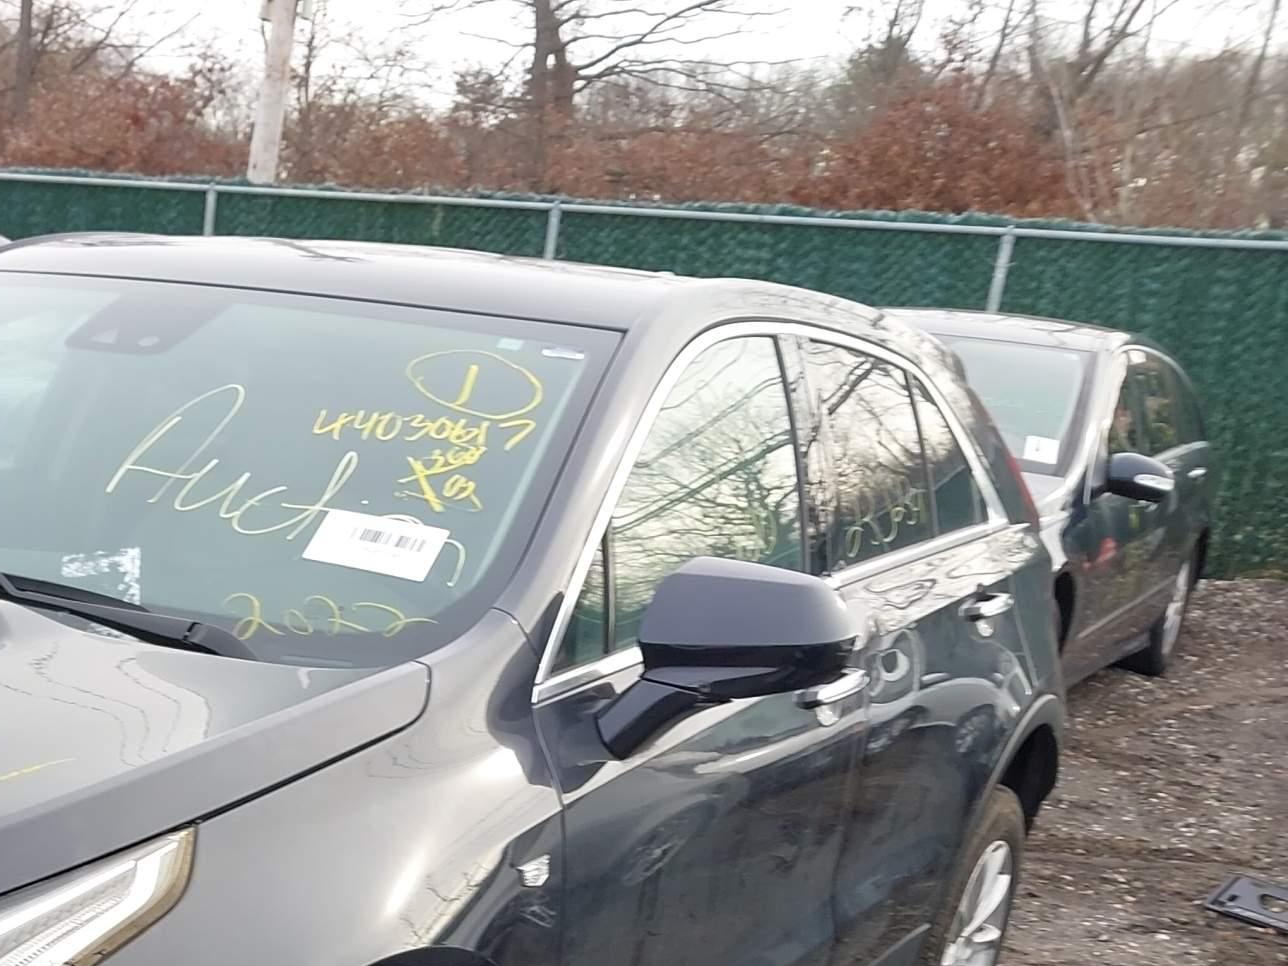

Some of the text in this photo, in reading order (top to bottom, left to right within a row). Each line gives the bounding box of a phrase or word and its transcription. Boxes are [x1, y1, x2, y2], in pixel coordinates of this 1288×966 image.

[312, 408, 537, 451] 44030617
[105, 383, 467, 588] Aucti
[223, 592, 440, 641] 2022
